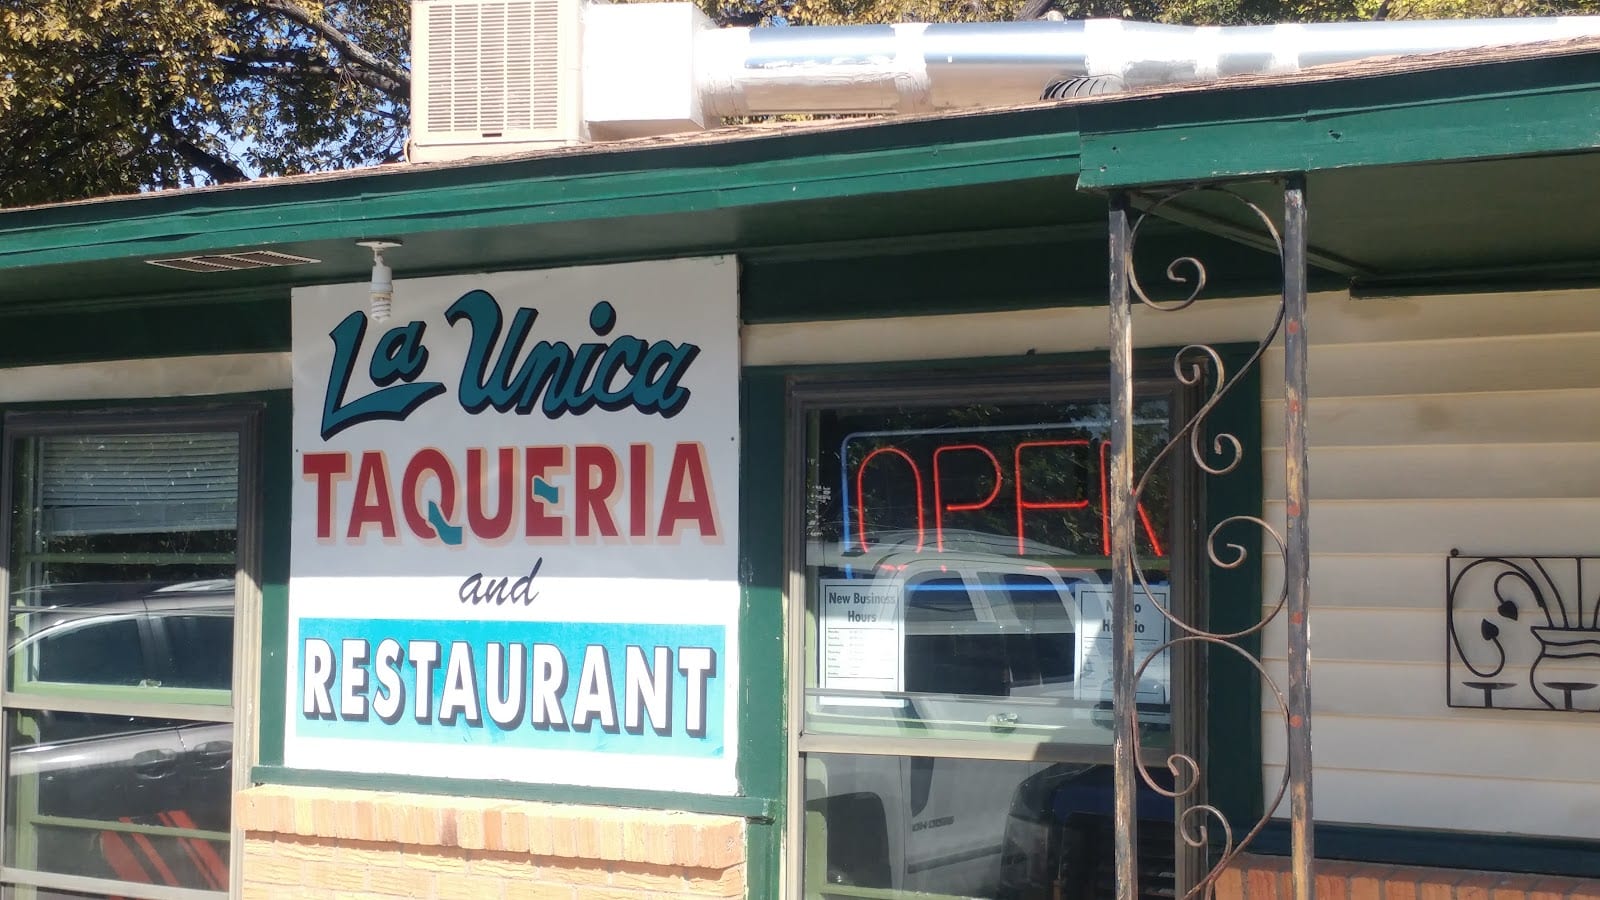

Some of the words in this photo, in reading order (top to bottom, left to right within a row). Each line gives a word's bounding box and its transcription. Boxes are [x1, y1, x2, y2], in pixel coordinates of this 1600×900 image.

[321, 311, 447, 441] La
[444, 289, 701, 419] Unica
[302, 441, 724, 545] TAQUERIA
[459, 557, 543, 606] and
[829, 592, 850, 604] New
[853, 592, 896, 604] Business
[847, 611, 877, 623] Hours
[303, 638, 716, 738] RESTAURANT
